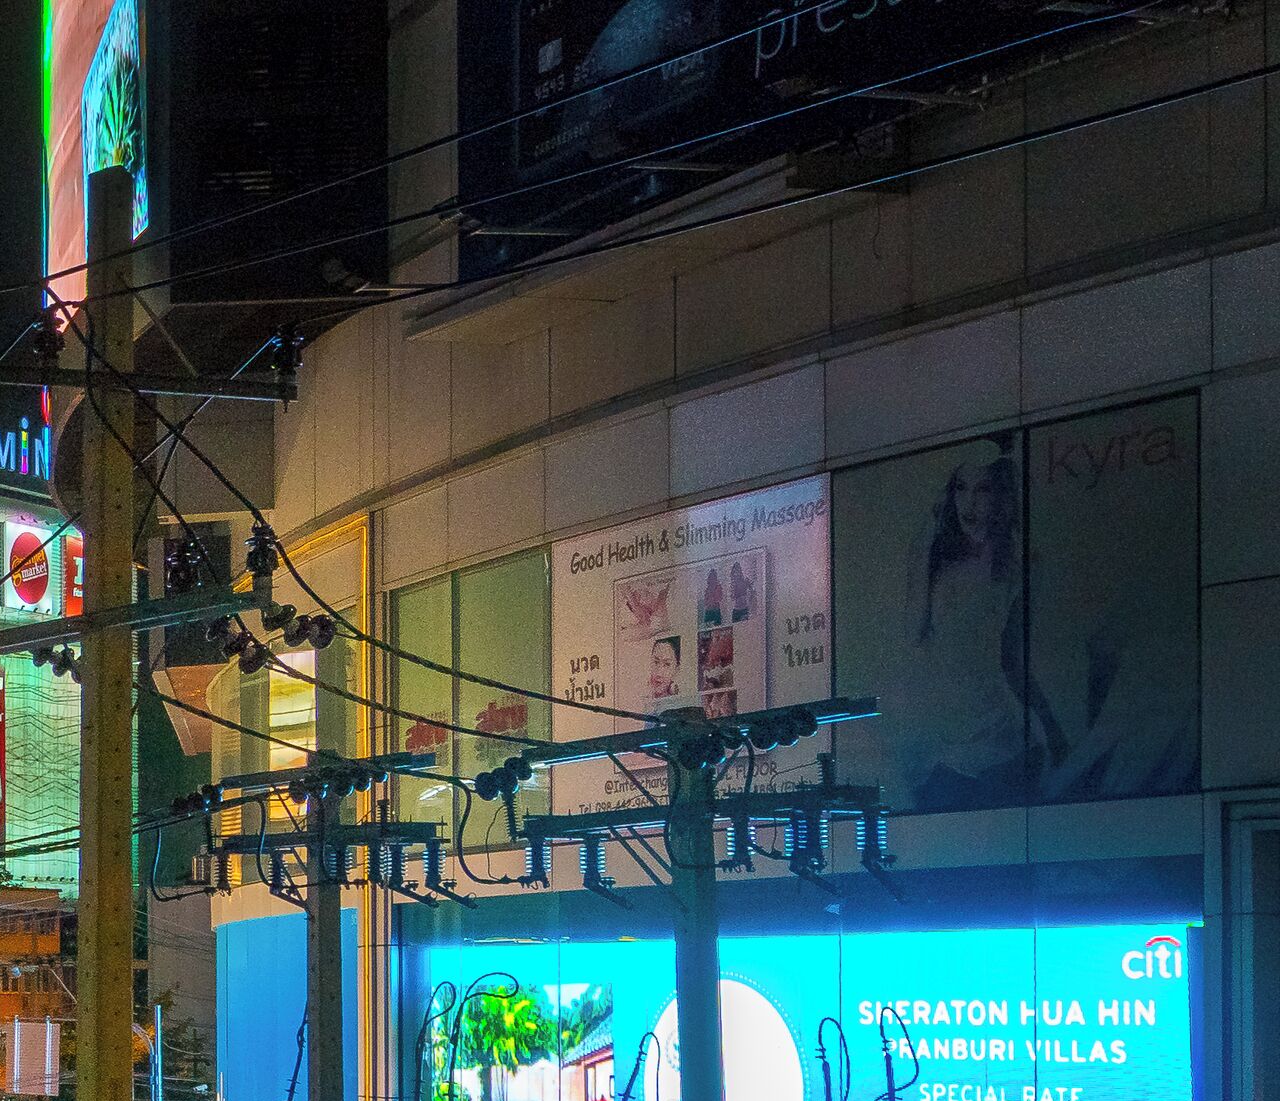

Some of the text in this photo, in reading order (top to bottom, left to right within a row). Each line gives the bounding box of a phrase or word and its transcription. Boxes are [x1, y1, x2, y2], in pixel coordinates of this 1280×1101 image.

[1048, 424, 1178, 490] kyra
[571, 499, 826, 575] Good Health & Slimming Massage
[21, 561, 47, 579] market
[569, 654, 600, 675] นวด
[1122, 944, 1182, 979] citi
[858, 999, 1156, 1026] SHERATON HUA HIN
[1026, 1038, 1128, 1065] VILLAS
